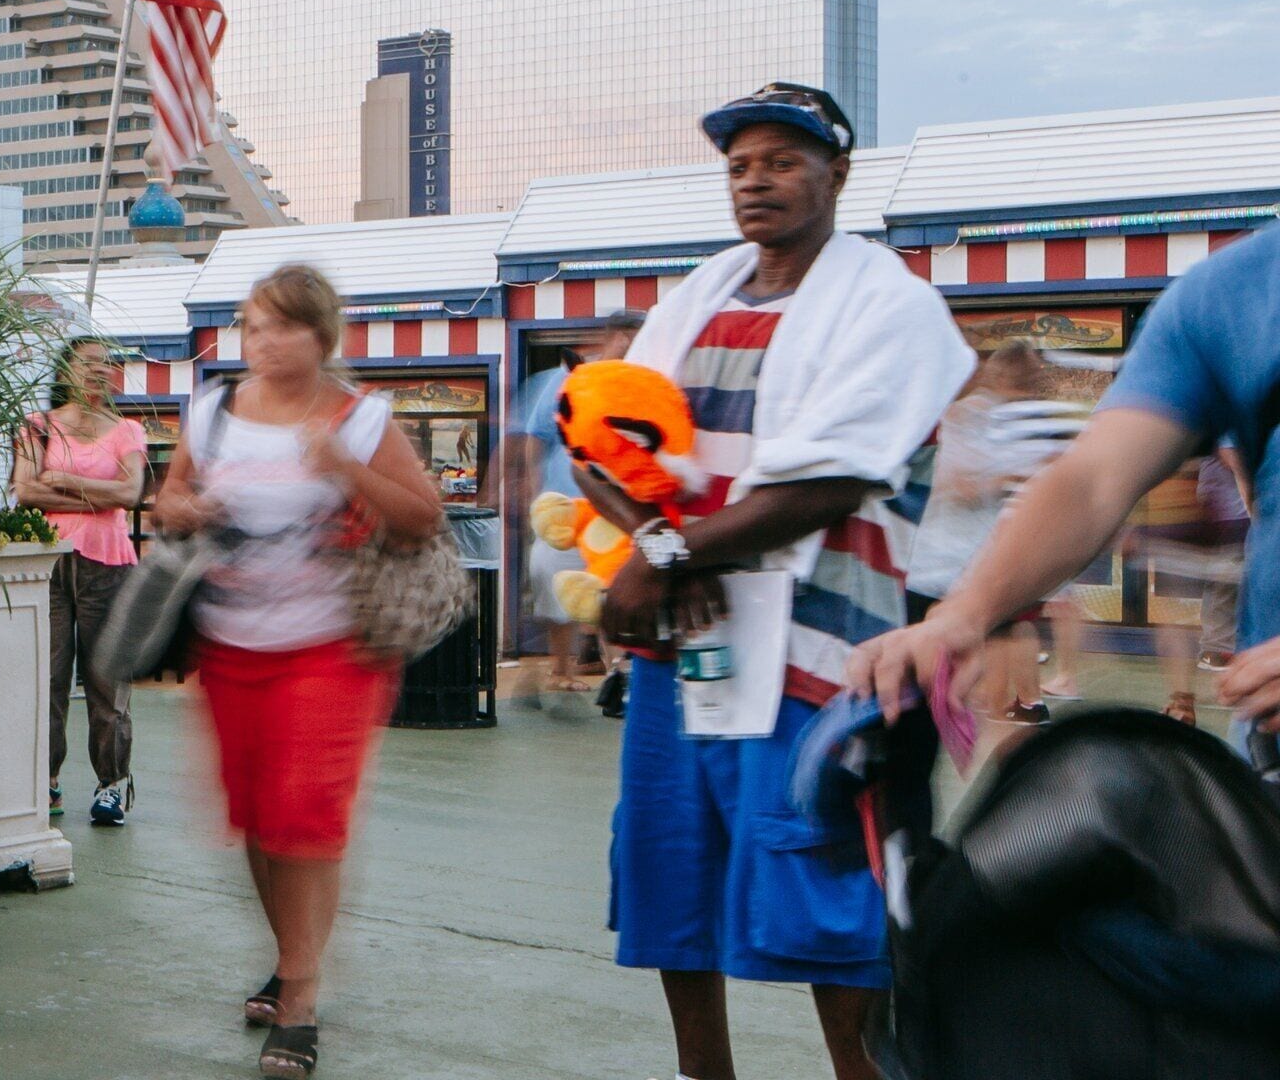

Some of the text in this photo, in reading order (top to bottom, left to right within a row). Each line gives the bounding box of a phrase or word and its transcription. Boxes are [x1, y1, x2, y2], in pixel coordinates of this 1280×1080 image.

[423, 58, 438, 212] HOUSE of BLUE
